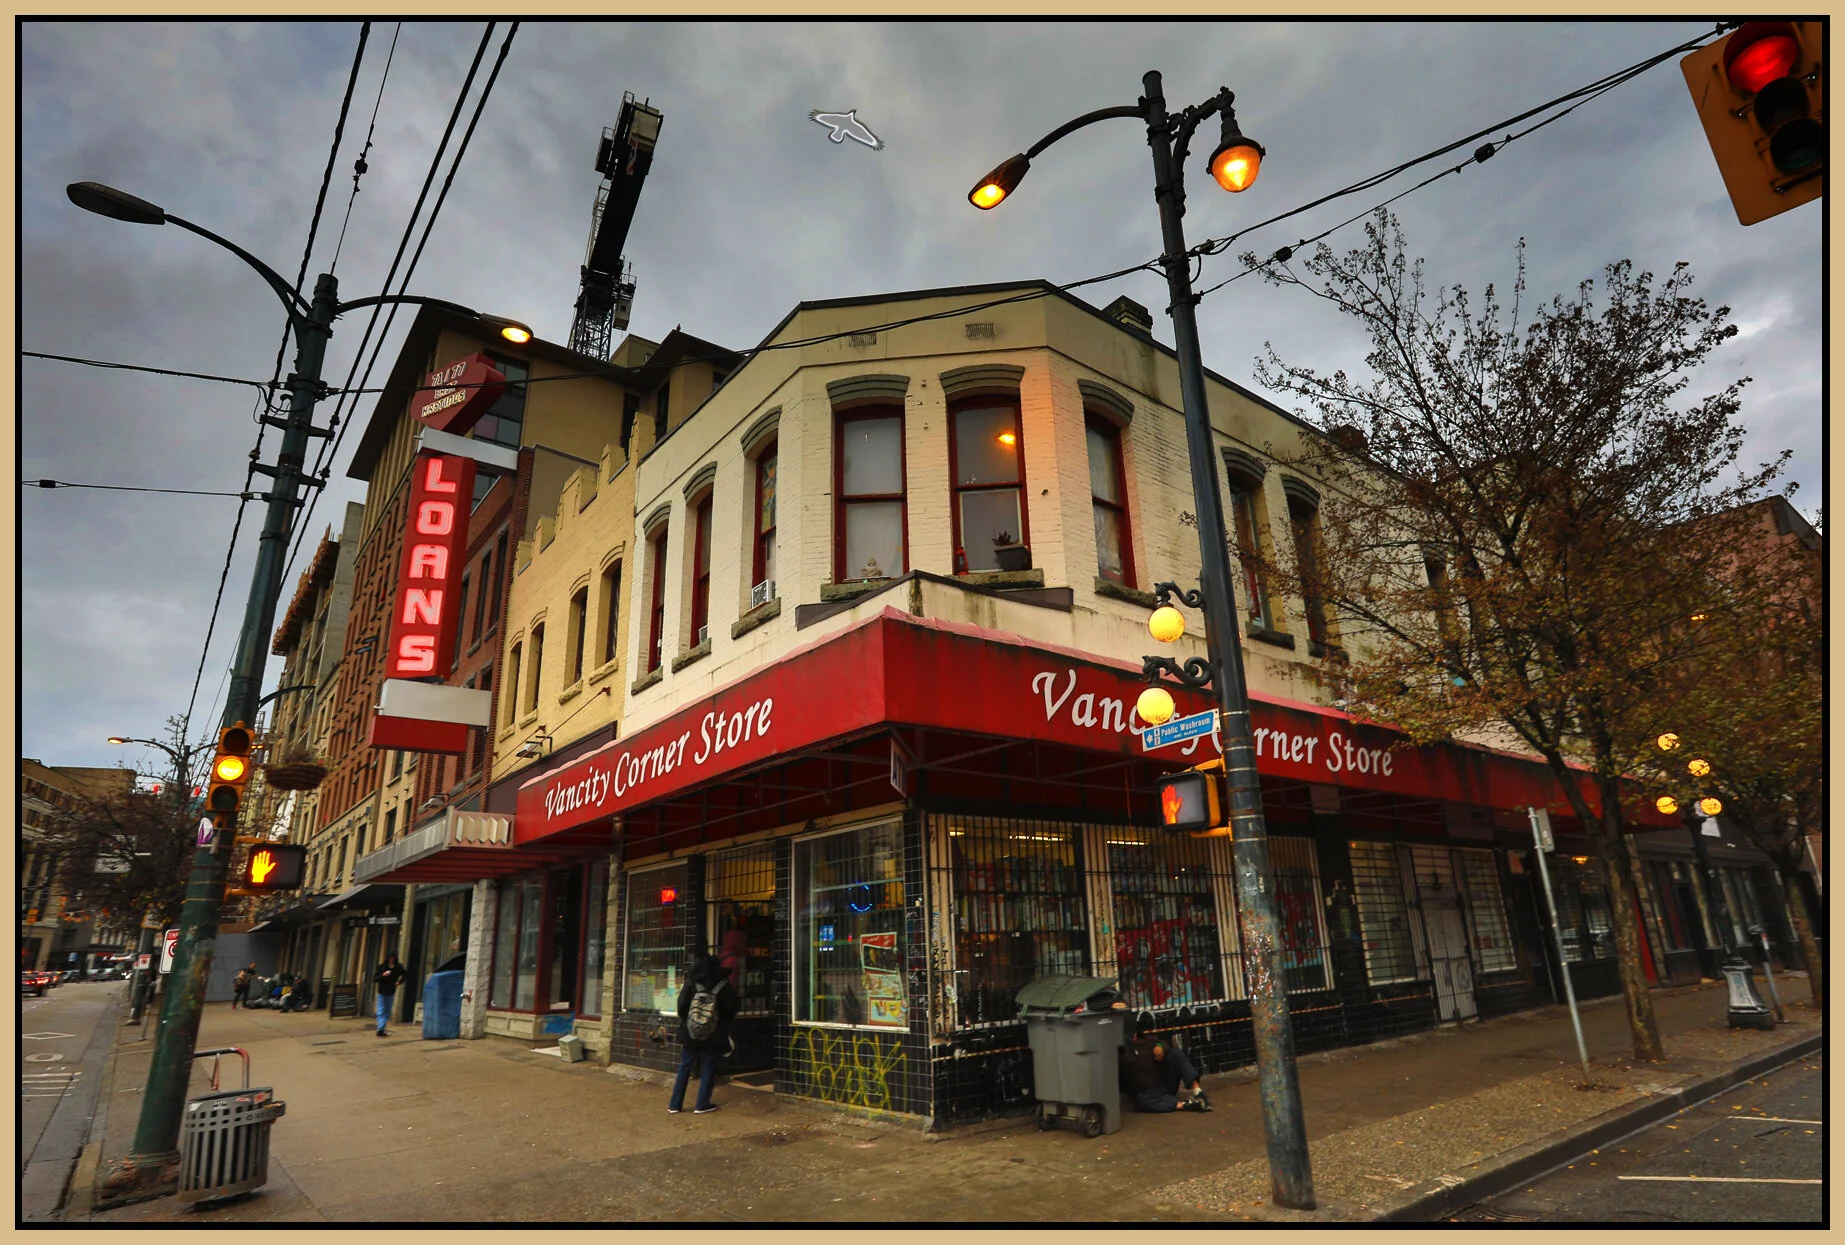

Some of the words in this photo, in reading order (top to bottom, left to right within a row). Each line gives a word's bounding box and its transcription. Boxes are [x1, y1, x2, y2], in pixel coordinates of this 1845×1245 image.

[396, 458, 456, 672] LOANS
[545, 766, 611, 821] Vancity
[614, 730, 691, 797] Corner
[694, 698, 773, 764] Store
[1161, 726, 1178, 736] Public
[1180, 717, 1210, 731] Washroom
[1212, 728, 1318, 764] rner
[1326, 732, 1393, 777] Store
